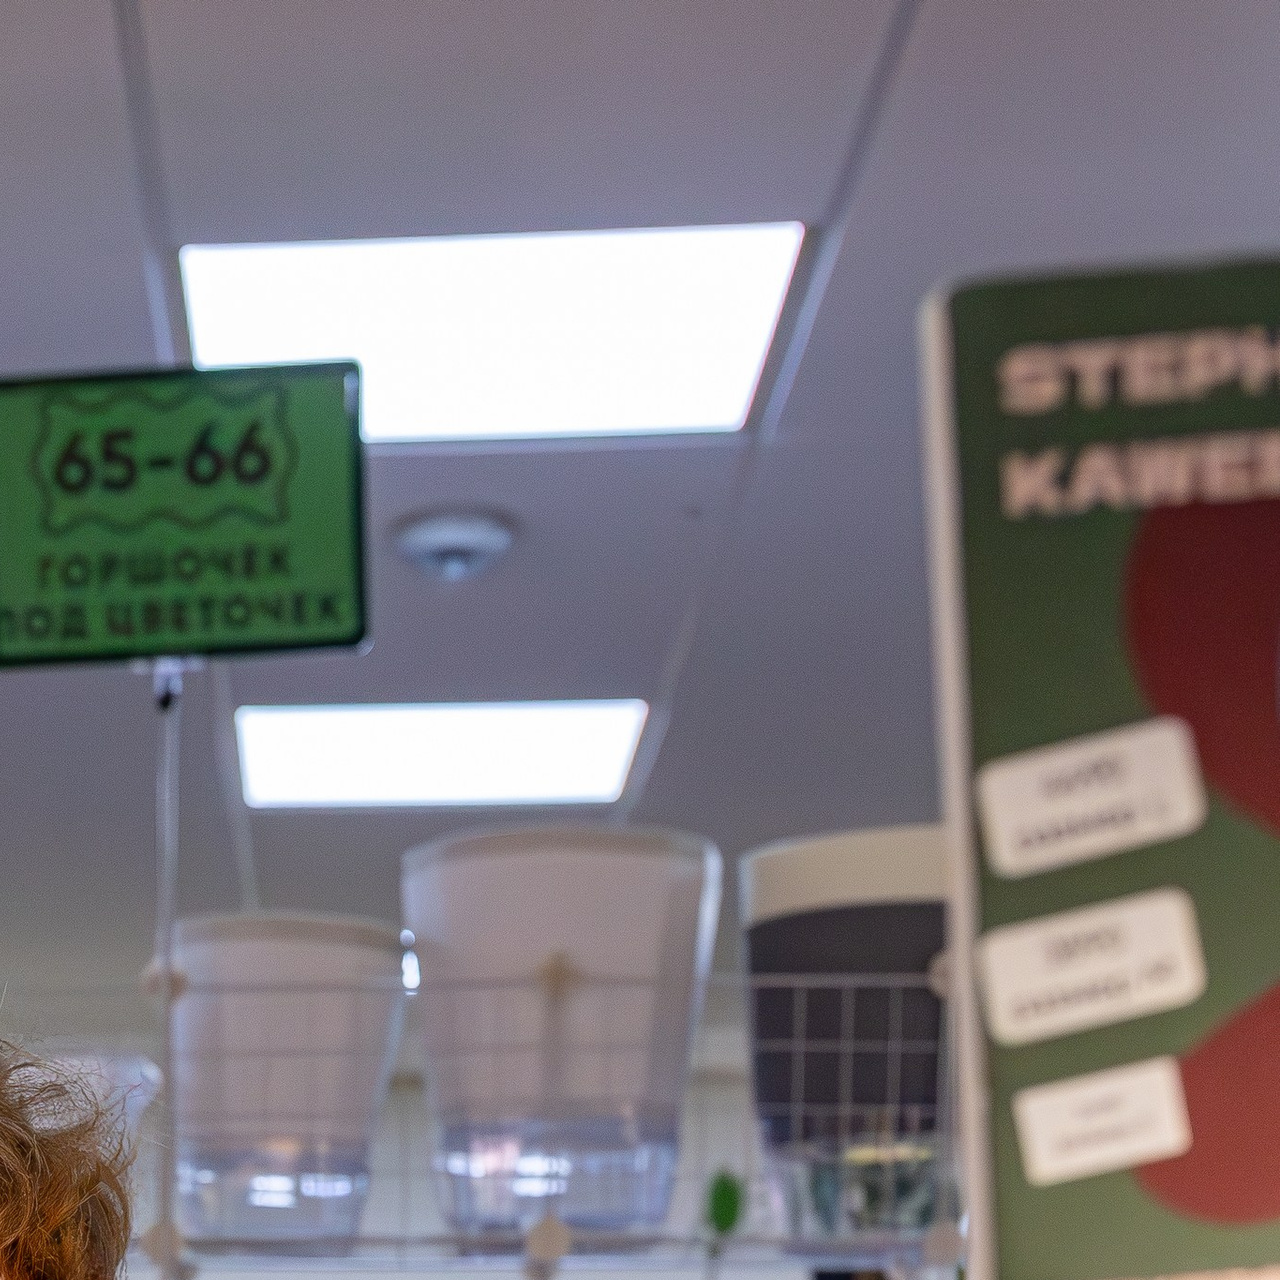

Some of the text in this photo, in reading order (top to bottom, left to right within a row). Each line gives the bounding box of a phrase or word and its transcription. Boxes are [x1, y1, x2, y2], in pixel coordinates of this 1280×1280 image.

[54, 419, 272, 492] 65-66
[37, 541, 291, 589] ГОРШОЧЕК
[106, 592, 340, 637] ЦВЕТОЧЕК
